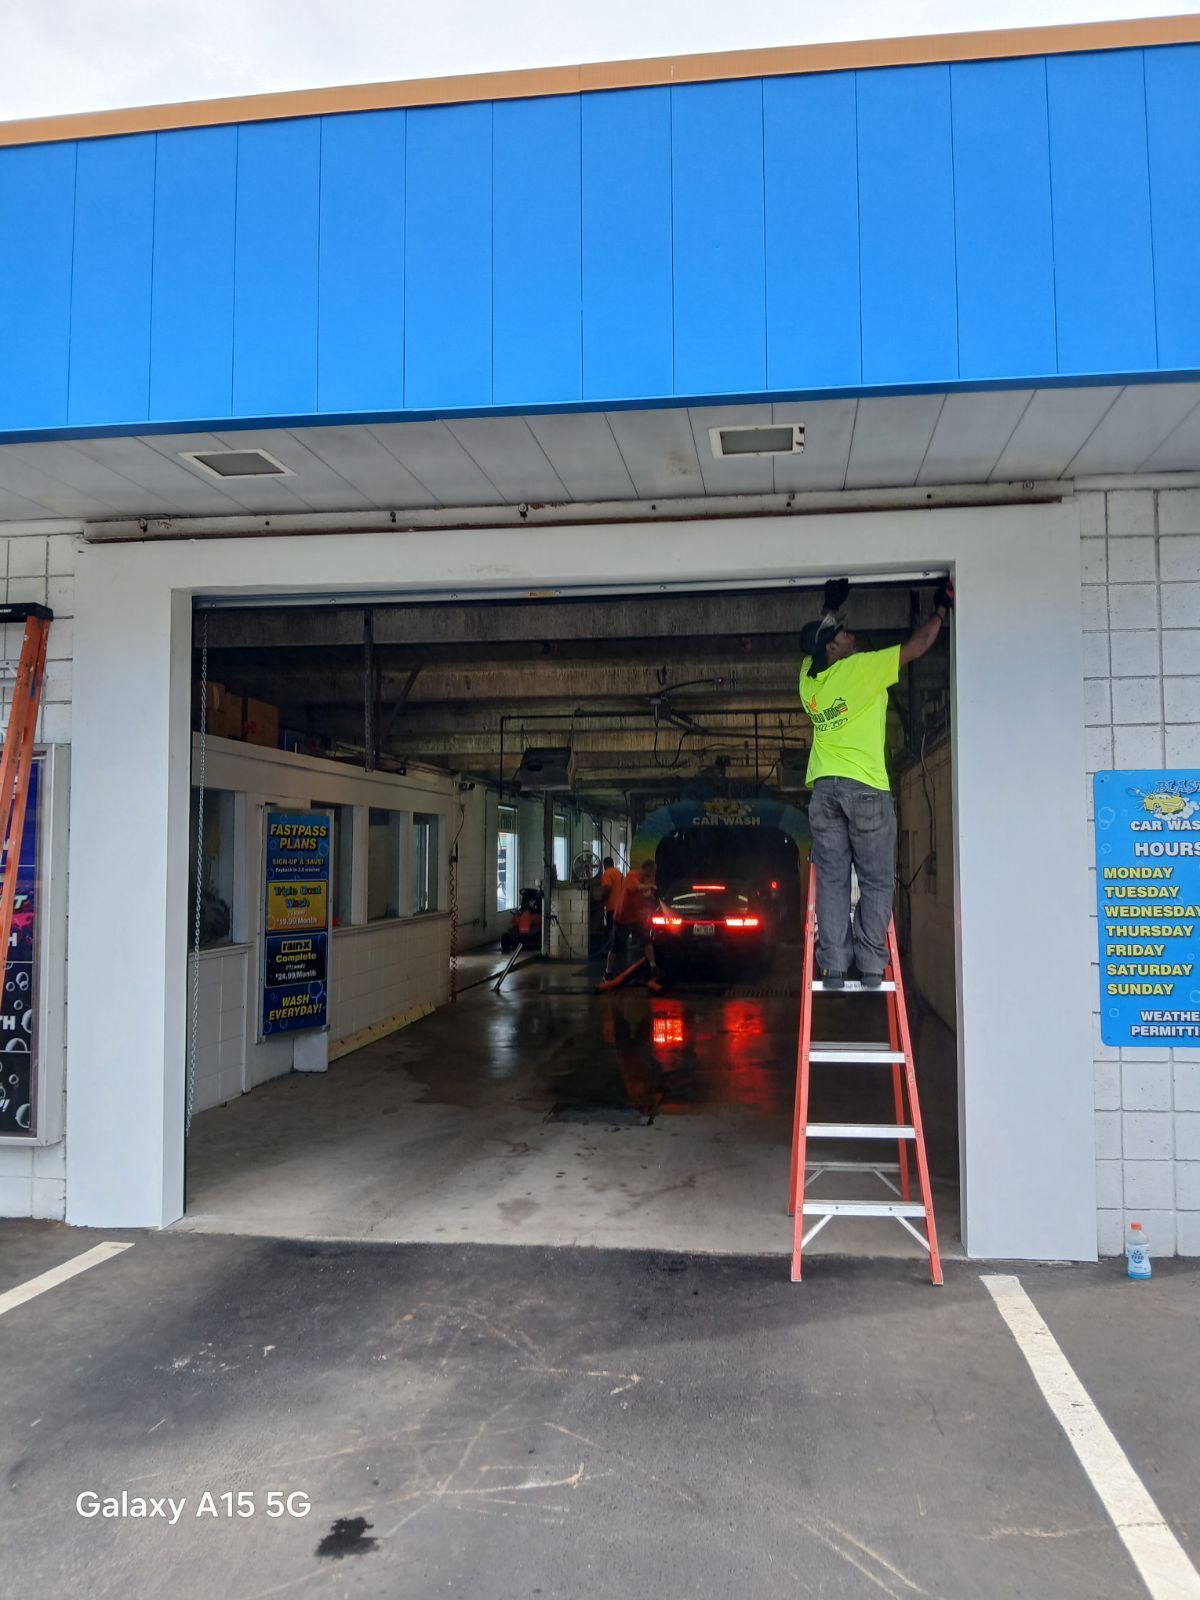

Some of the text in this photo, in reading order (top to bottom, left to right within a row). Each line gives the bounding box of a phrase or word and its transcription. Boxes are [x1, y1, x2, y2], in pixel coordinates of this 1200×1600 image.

[692, 816, 760, 826] CAR WASH
[1130, 820, 1162, 831] CAR
[270, 824, 327, 837] FASTPASS
[280, 838, 317, 850] PLANS
[1103, 867, 1174, 879] MONDAY
[1103, 886, 1180, 899] TUESDAY
[1104, 905, 1200, 918] WEDNESDAY
[1105, 925, 1194, 938] THURSDAY
[1106, 944, 1165, 957] FRIDAY
[275, 952, 317, 963] Complete
[1107, 964, 1193, 977] SATURDAY
[1107, 983, 1175, 996] SUNDAY
[282, 994, 310, 1007] WASH
[268, 1003, 322, 1021] EVERYDAY!
